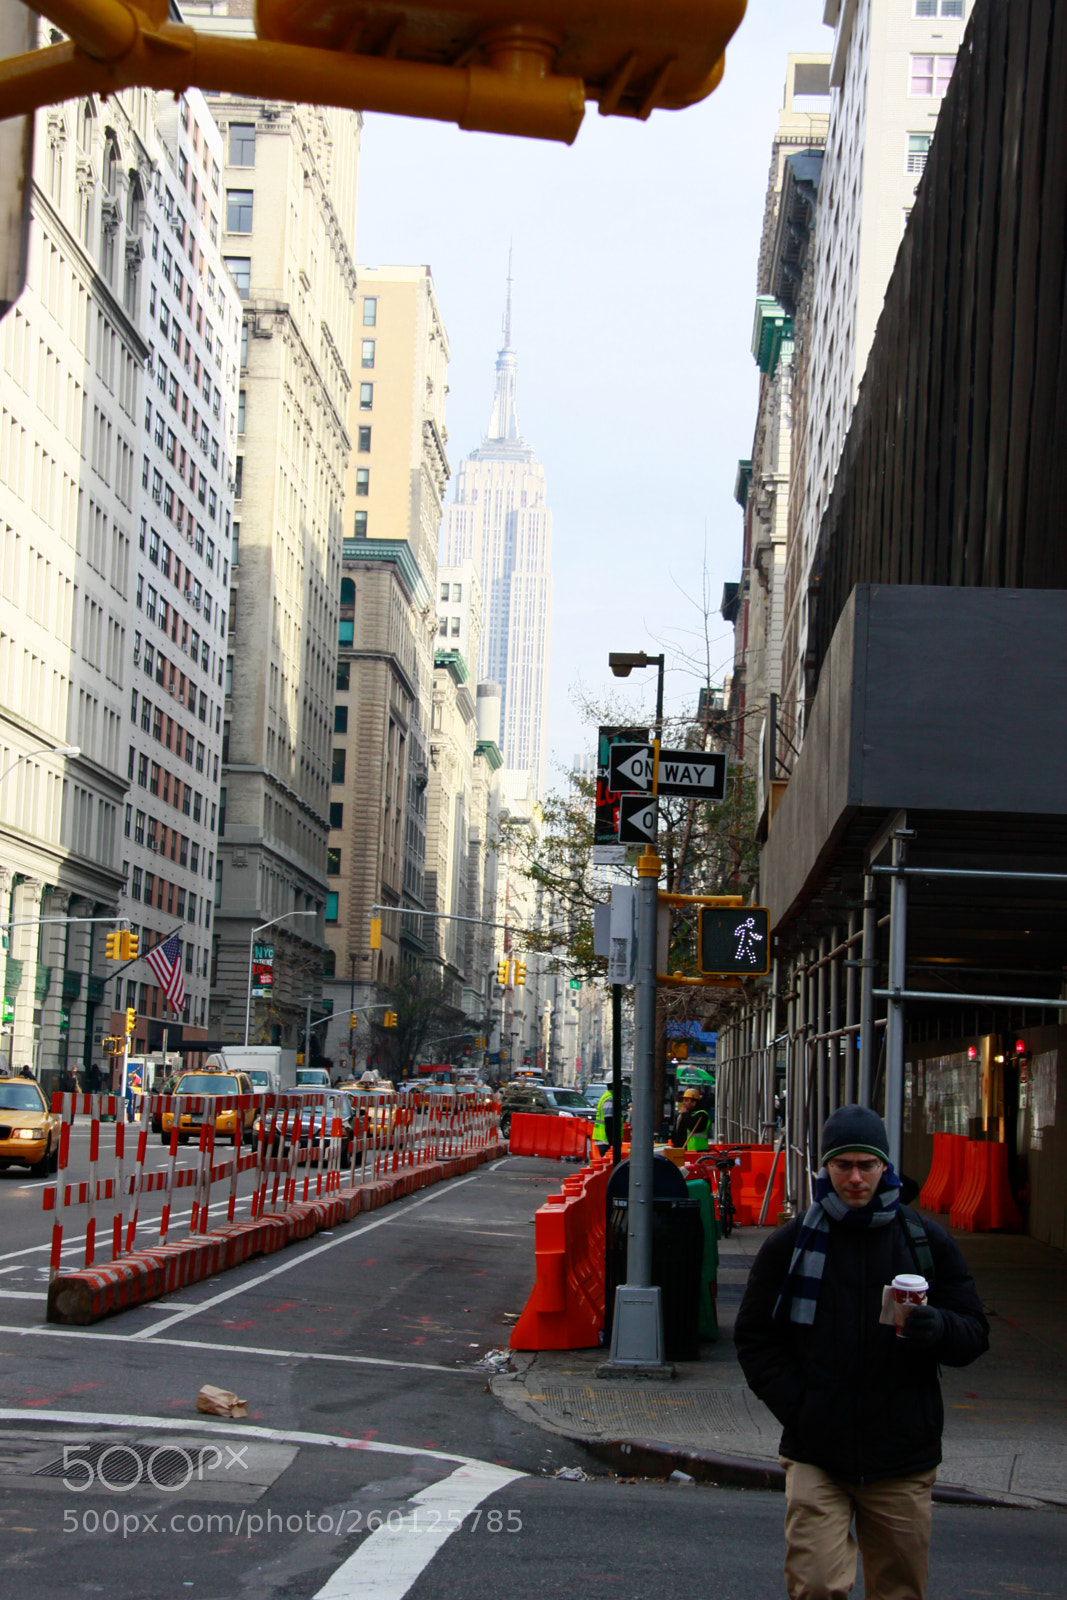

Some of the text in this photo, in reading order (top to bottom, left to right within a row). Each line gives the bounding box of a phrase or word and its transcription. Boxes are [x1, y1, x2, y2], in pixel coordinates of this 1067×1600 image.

[631, 760, 654, 779] ON
[665, 764, 707, 784] WAY
[255, 946, 274, 958] NYC
